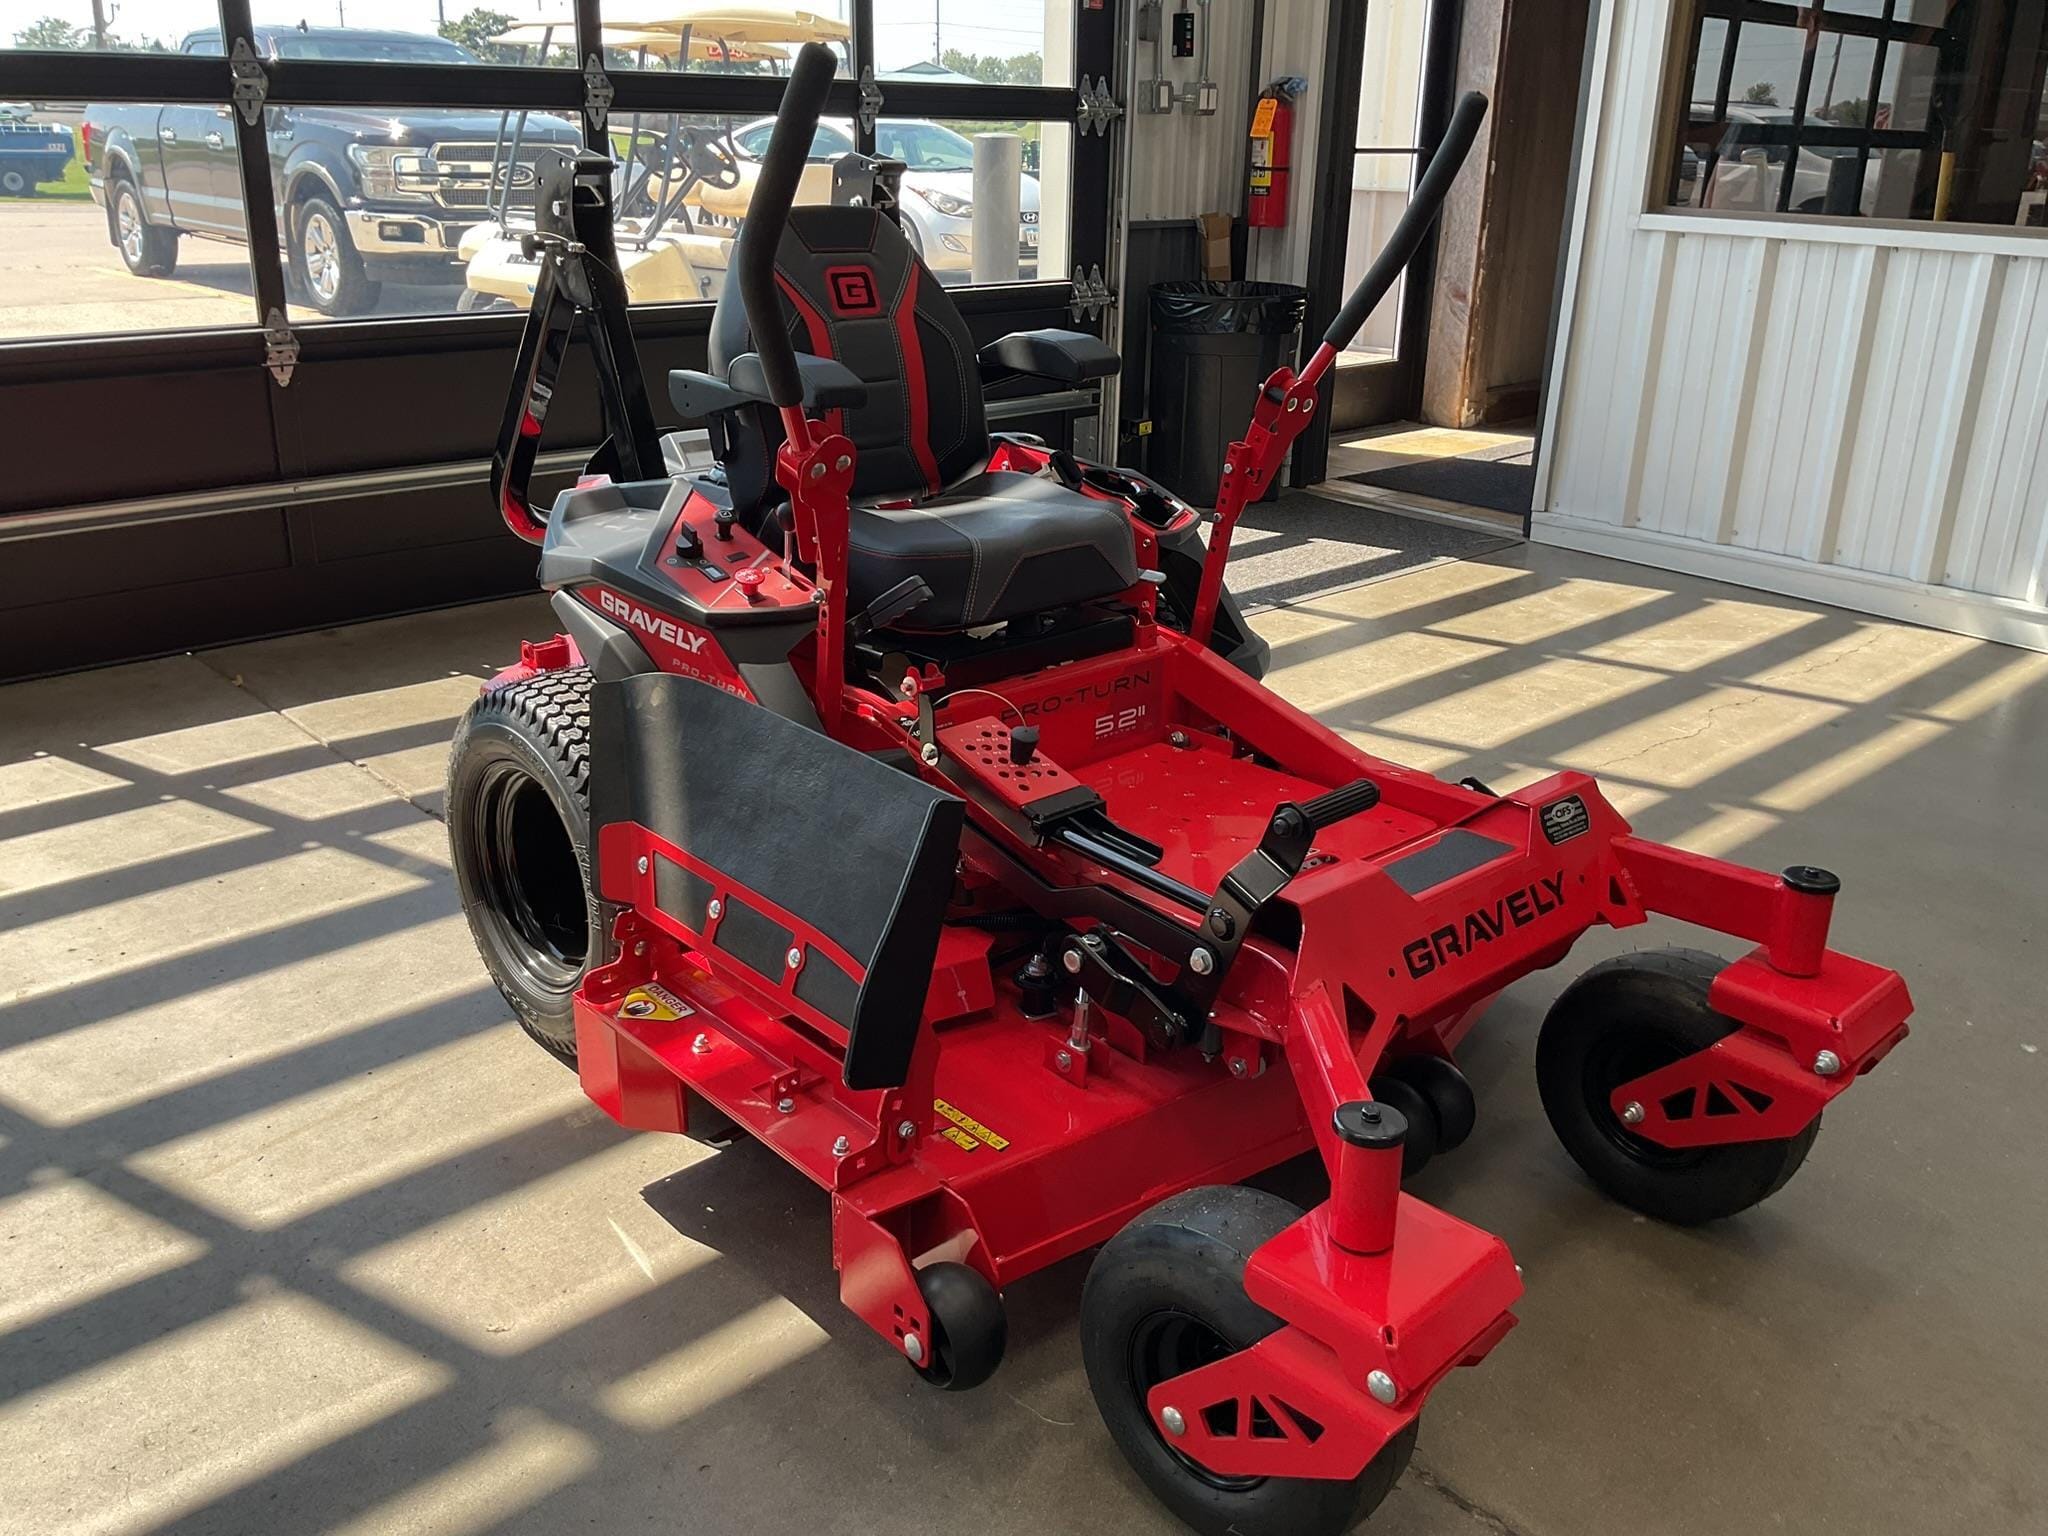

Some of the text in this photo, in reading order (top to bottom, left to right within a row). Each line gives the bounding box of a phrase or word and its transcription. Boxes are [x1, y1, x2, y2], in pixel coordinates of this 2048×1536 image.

[600, 589, 707, 654] GRAVELY
[672, 658, 747, 698] PRO-TURN
[1001, 671, 1151, 721] PRO-TURN
[1402, 869, 1566, 980] GRAVELY
[647, 985, 687, 1013] DANGER
